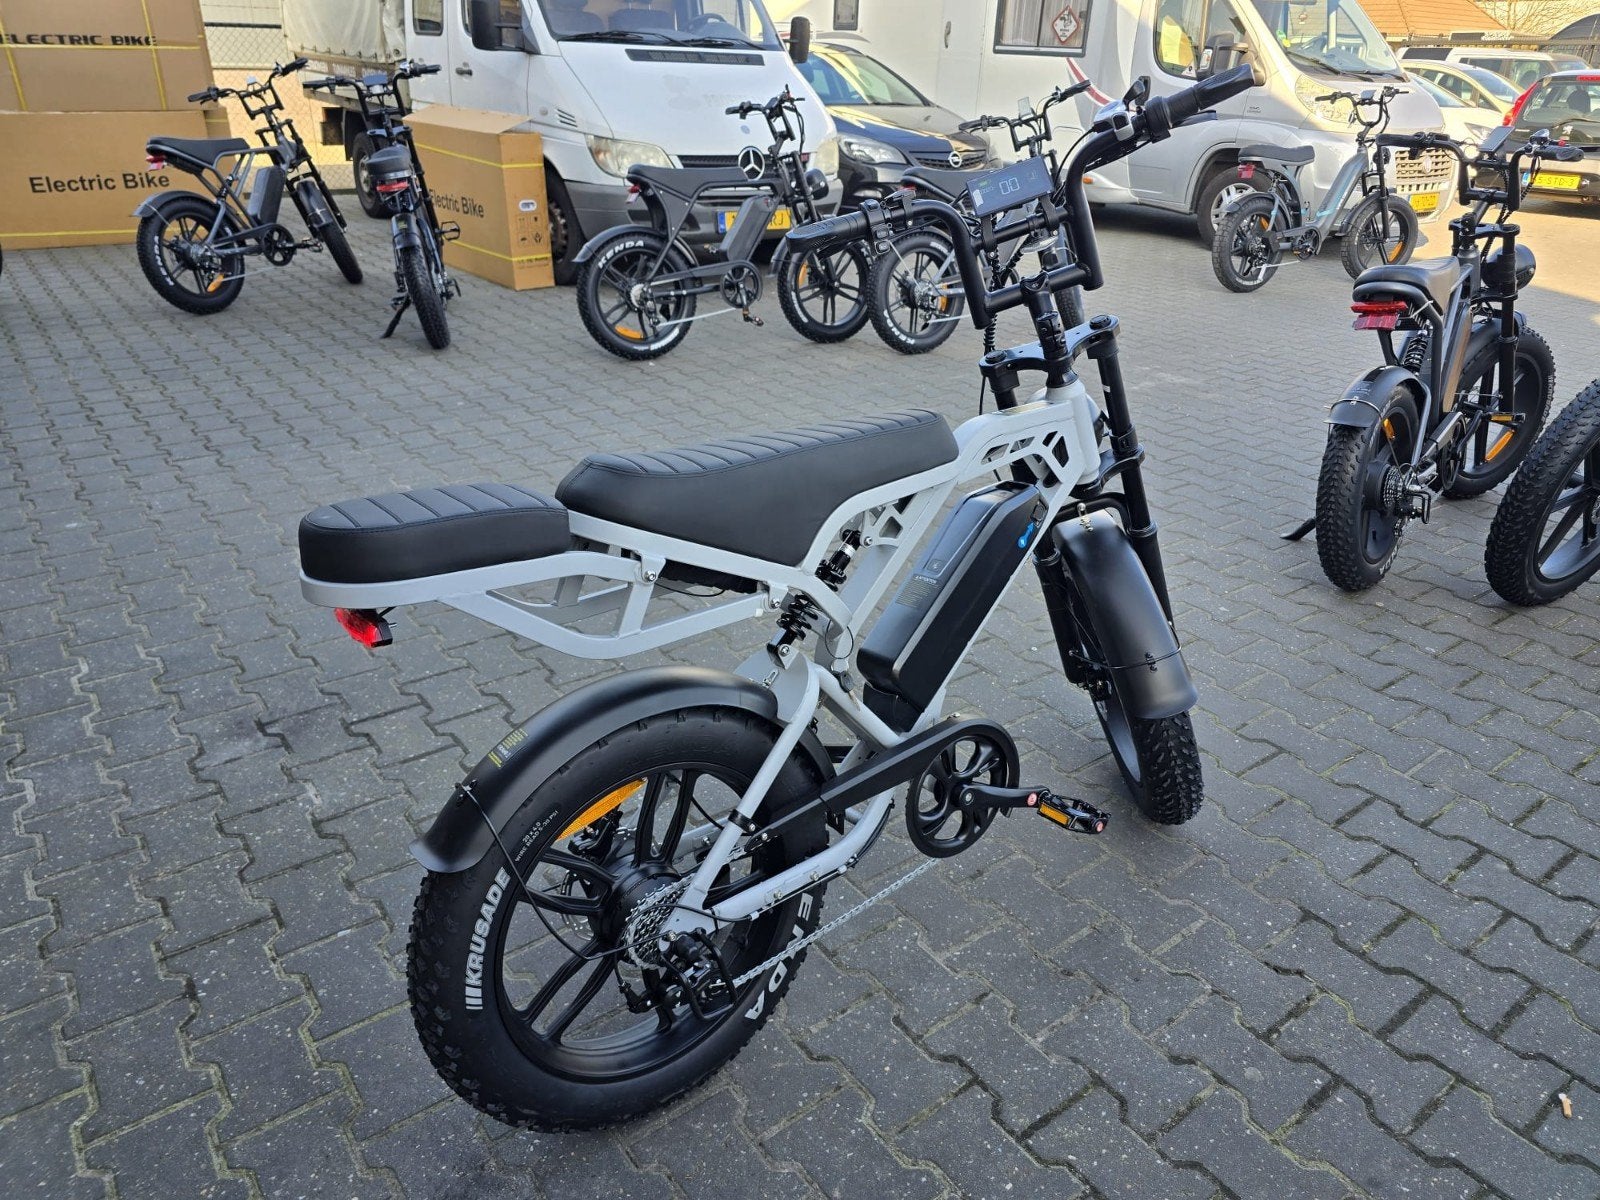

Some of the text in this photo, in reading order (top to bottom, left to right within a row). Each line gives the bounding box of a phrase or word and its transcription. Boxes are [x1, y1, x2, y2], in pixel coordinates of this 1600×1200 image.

[0, 33, 157, 46] ELECTRIC BIKE
[29, 171, 170, 193] Electric Bike
[999, 177, 1020, 195] 00
[1536, 175, 1576, 187] 5-STD-3
[429, 189, 485, 218] Electric Bike
[598, 240, 645, 269] KENDA
[465, 866, 511, 987] KRUSADE
[744, 892, 814, 1020] ENDA
